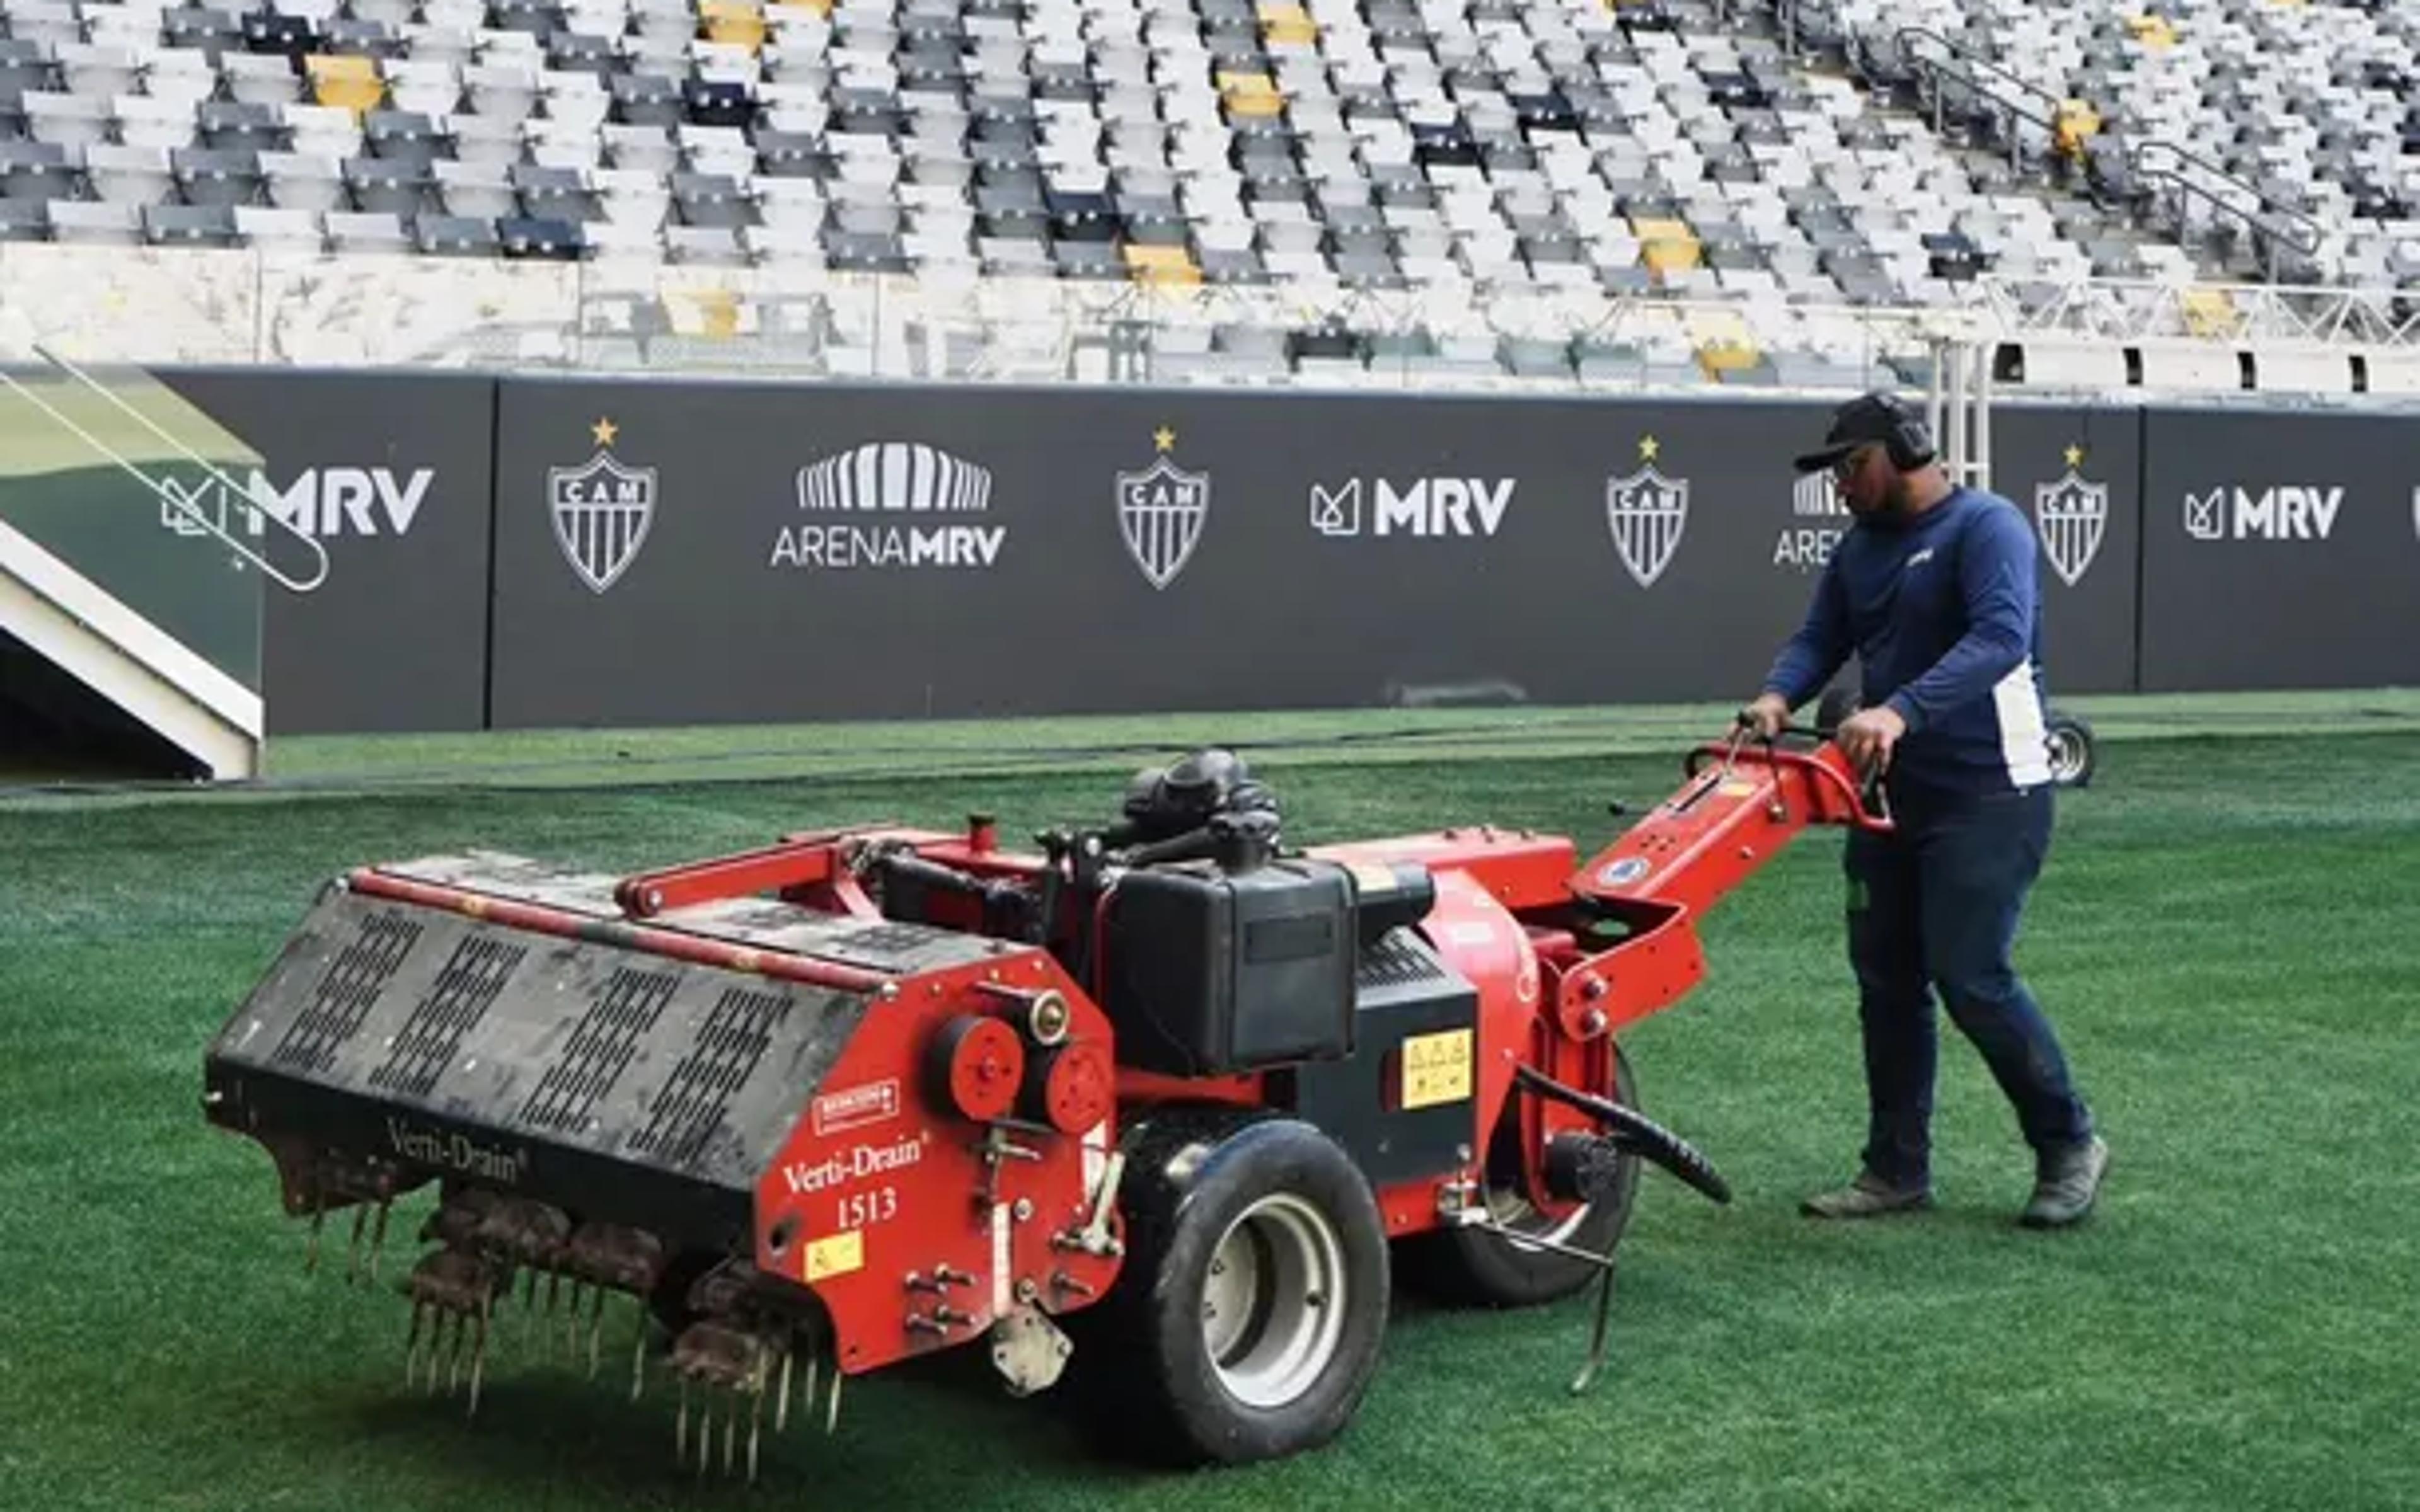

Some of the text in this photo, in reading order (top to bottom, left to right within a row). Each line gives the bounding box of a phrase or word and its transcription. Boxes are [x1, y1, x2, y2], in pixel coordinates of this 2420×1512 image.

[248, 468, 435, 536] MRV
[565, 481, 638, 503] CAM
[1131, 486, 1194, 505] CAM
[1374, 478, 1516, 536] MRV
[1619, 490, 1676, 509] CAM
[2233, 486, 2344, 539] MRV
[783, 1135, 921, 1193] Verti-Drain
[838, 1187, 897, 1228] 1513
